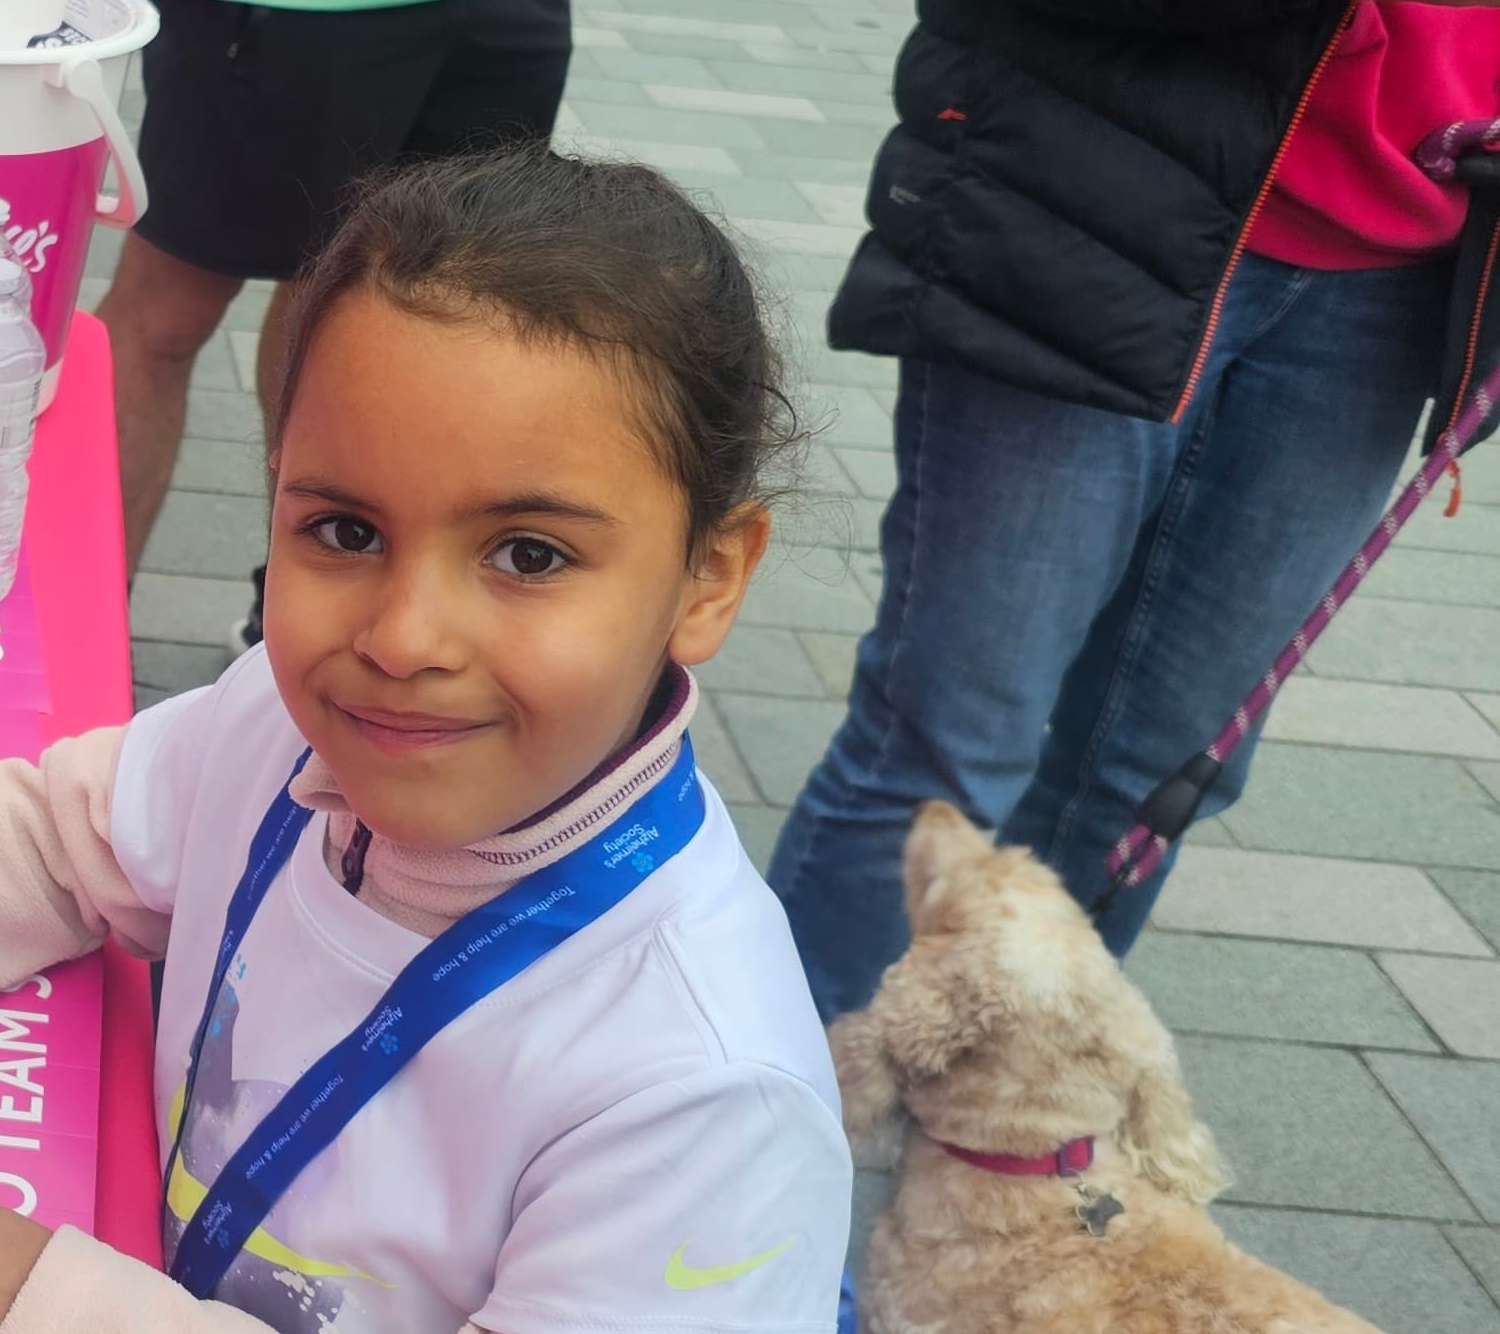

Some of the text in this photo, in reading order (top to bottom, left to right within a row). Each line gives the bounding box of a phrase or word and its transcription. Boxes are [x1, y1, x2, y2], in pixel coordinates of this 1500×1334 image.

[602, 822, 646, 855] Society
[603, 825, 661, 869] Alzheimer's
[431, 884, 576, 983] Together we are help & hope
[361, 1005, 404, 1053] Alzheimer's
[364, 1005, 392, 1037] Society
[308, 1073, 345, 1112] Together
[271, 1133, 291, 1156] help
[288, 1120, 302, 1138] are
[245, 1158, 266, 1181] hope
